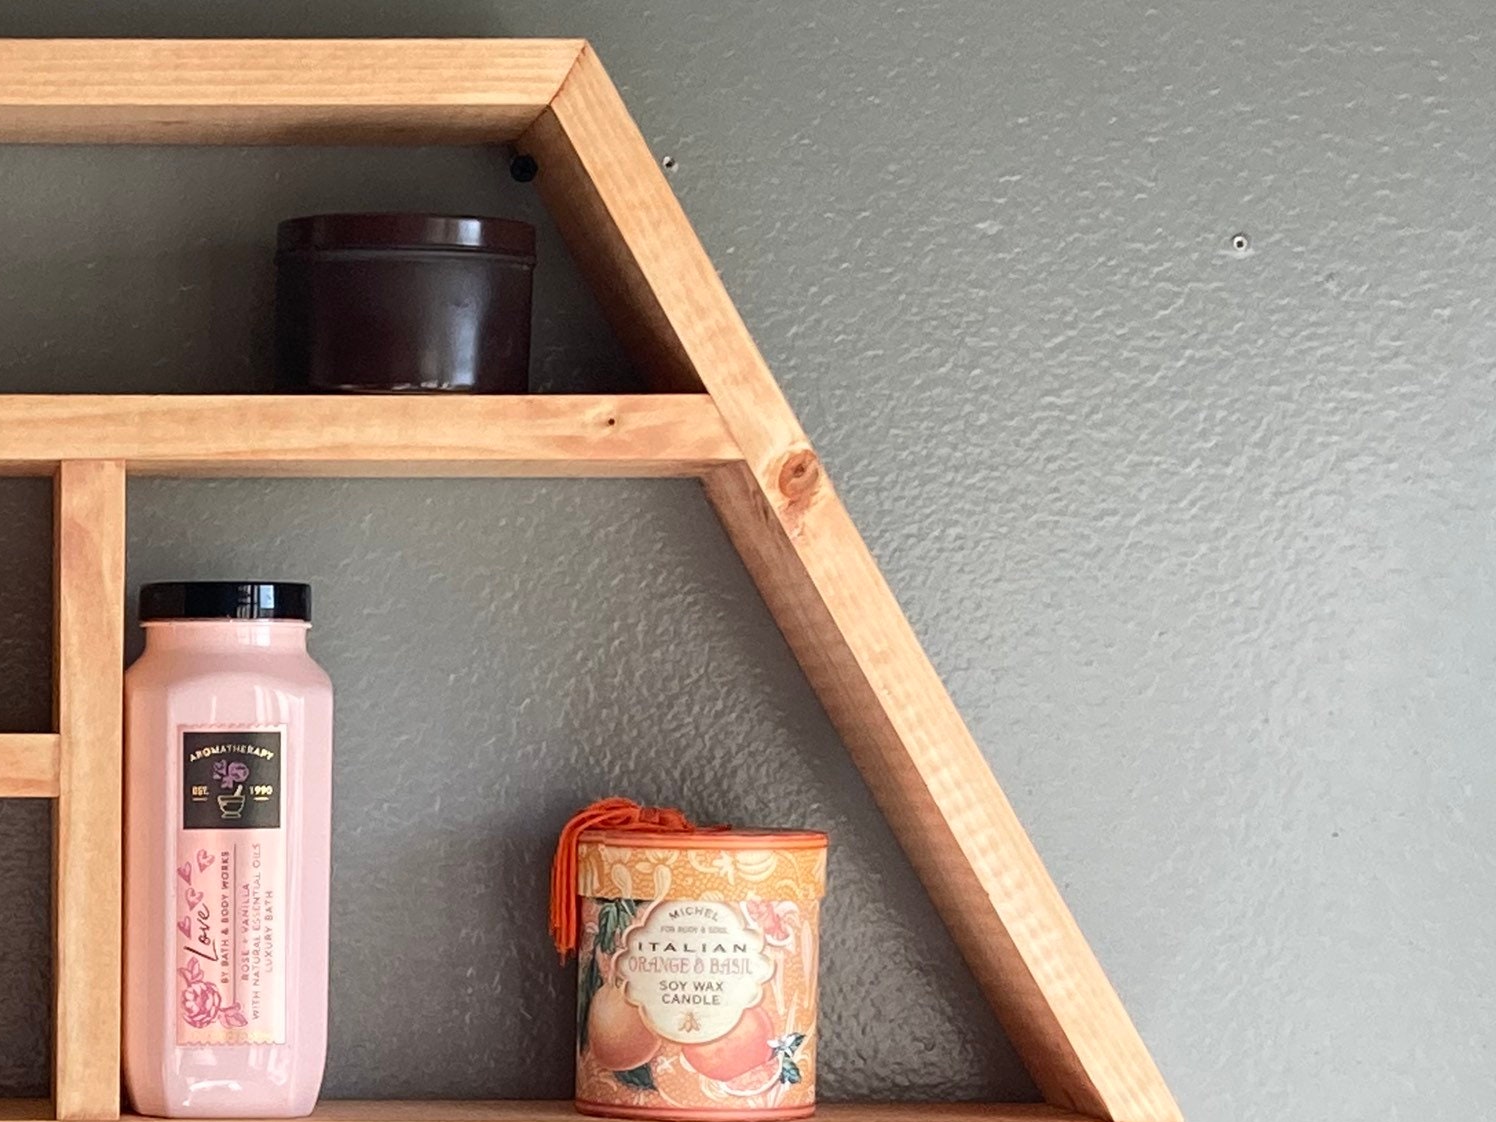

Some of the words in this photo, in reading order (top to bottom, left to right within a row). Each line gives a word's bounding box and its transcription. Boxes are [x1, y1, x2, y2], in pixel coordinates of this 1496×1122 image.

[189, 744, 274, 762] AROMATHERAPY
[249, 785, 273, 796] 1990
[251, 843, 261, 869] OILS
[220, 851, 229, 890] WORKS
[220, 894, 229, 923] BODY
[241, 883, 250, 934] VANILLA
[251, 872, 261, 931] ESSENTIAL
[265, 890, 273, 920] BATH
[669, 906, 719, 922] MICHEL
[183, 902, 219, 961] Love
[220, 939, 229, 967] BATH
[251, 935, 261, 987] NATURAL
[265, 926, 273, 973] LUXURY
[638, 942, 747, 953] ITALIAN
[220, 972, 229, 984] BY
[241, 949, 250, 981] ROSE
[628, 956, 689, 974] ORANGE
[710, 957, 754, 975] BASIL
[659, 980, 688, 991] SOY
[693, 981, 724, 992] WAX
[661, 993, 721, 1006] CANDLE
[251, 990, 261, 1020] WITH
